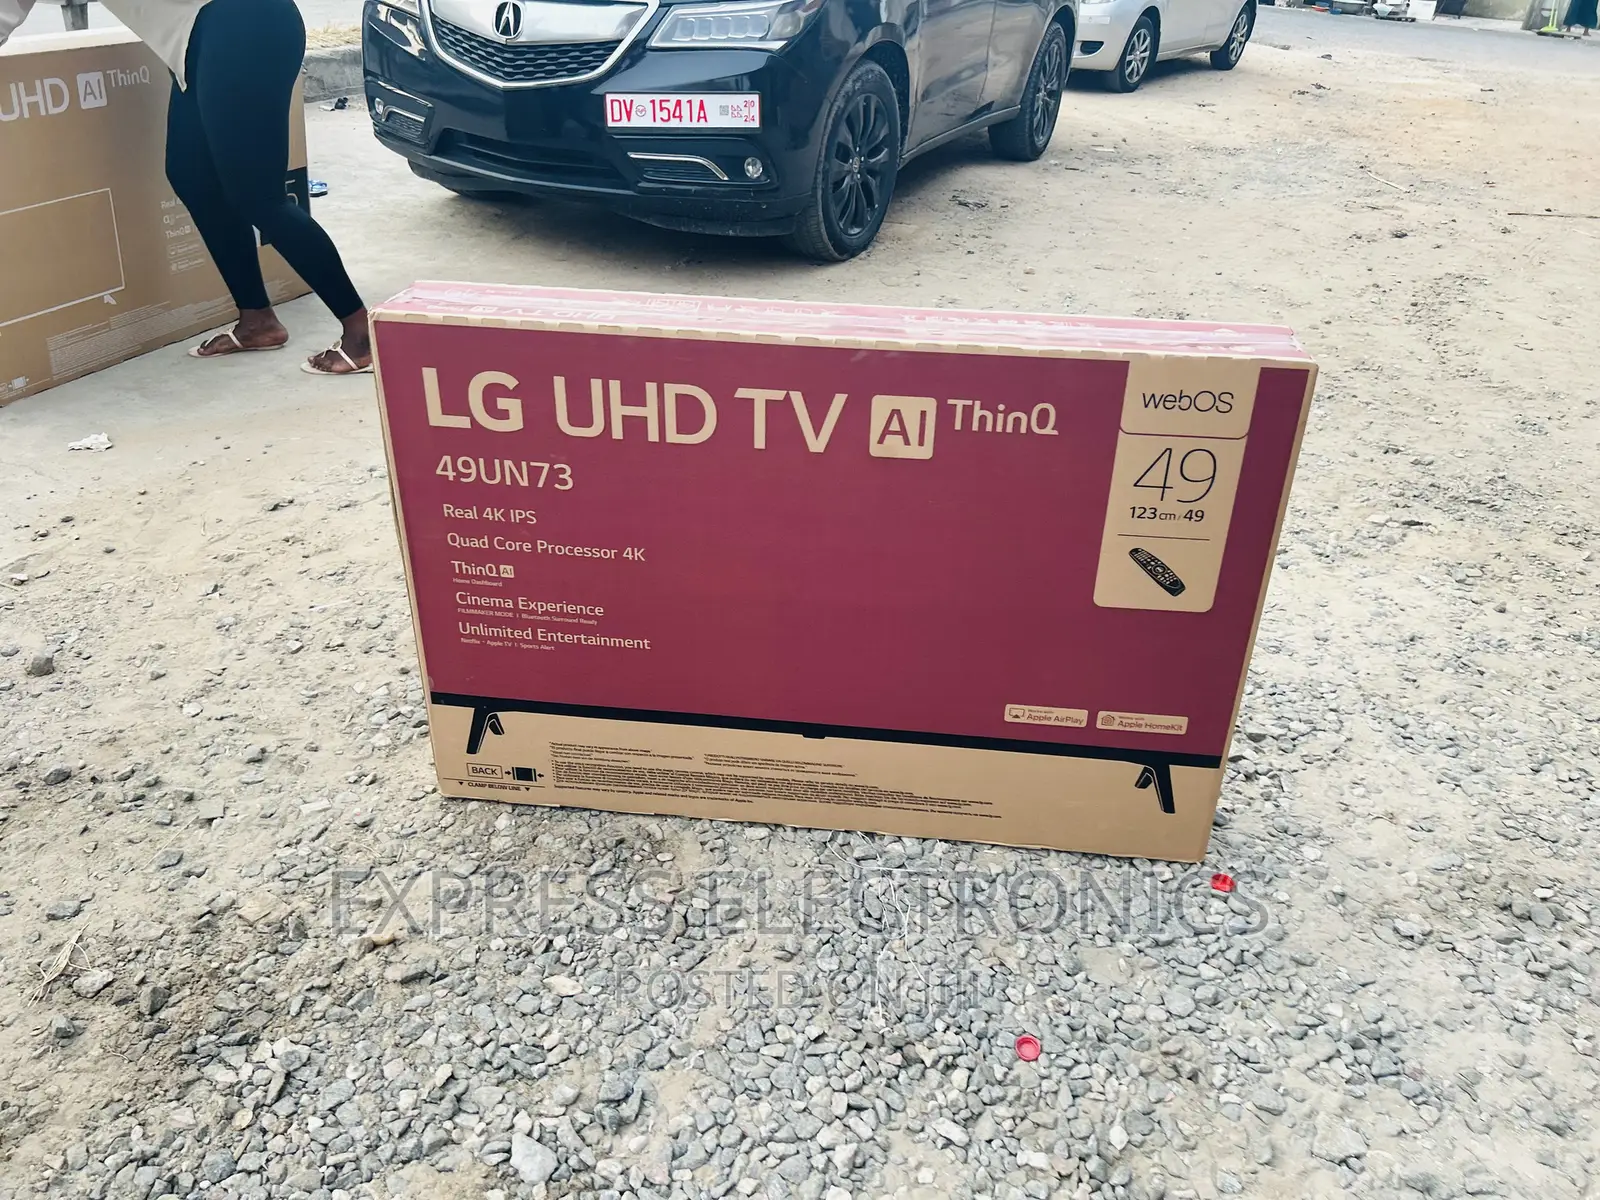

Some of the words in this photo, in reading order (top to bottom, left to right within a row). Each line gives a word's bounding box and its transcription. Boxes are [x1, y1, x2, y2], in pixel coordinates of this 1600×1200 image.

[81, 77, 105, 104] AI
[106, 65, 151, 88] ThinQ
[610, 98, 634, 123] DV
[649, 98, 708, 123] 1541A
[422, 367, 524, 433] LG
[553, 376, 717, 445] UHD
[734, 387, 849, 454] TV
[874, 405, 929, 450] AI
[946, 398, 1060, 436] ThinQ
[1142, 389, 1235, 414] webOS
[435, 455, 574, 491] 49UN73
[1133, 447, 1217, 503] 49
[442, 503, 479, 520] Real
[482, 507, 506, 522] 4K
[510, 509, 538, 525] IPS
[1129, 506, 1158, 520] 123
[1183, 509, 1205, 523] 49
[446, 532, 490, 550] Quad
[493, 536, 533, 553] Core
[536, 539, 619, 560] Processor
[622, 547, 646, 562] 4K
[450, 560, 499, 578] ThinQ
[471, 578, 503, 587] Dashboard
[455, 591, 514, 609] Cinema
[517, 597, 605, 617] Experience
[457, 607, 495, 617] FILMMAKER
[458, 621, 533, 640] Unlimited
[536, 628, 652, 650] Entertainment
[486, 640, 504, 648] Apple
[519, 642, 540, 650] Sports
[539, 643, 556, 651] Alert
[1026, 713, 1052, 723] Apple
[1053, 715, 1085, 726] AirPlay
[1117, 719, 1143, 730] Apple
[1144, 722, 1184, 733] HomeKit
[471, 766, 499, 776] BACK
